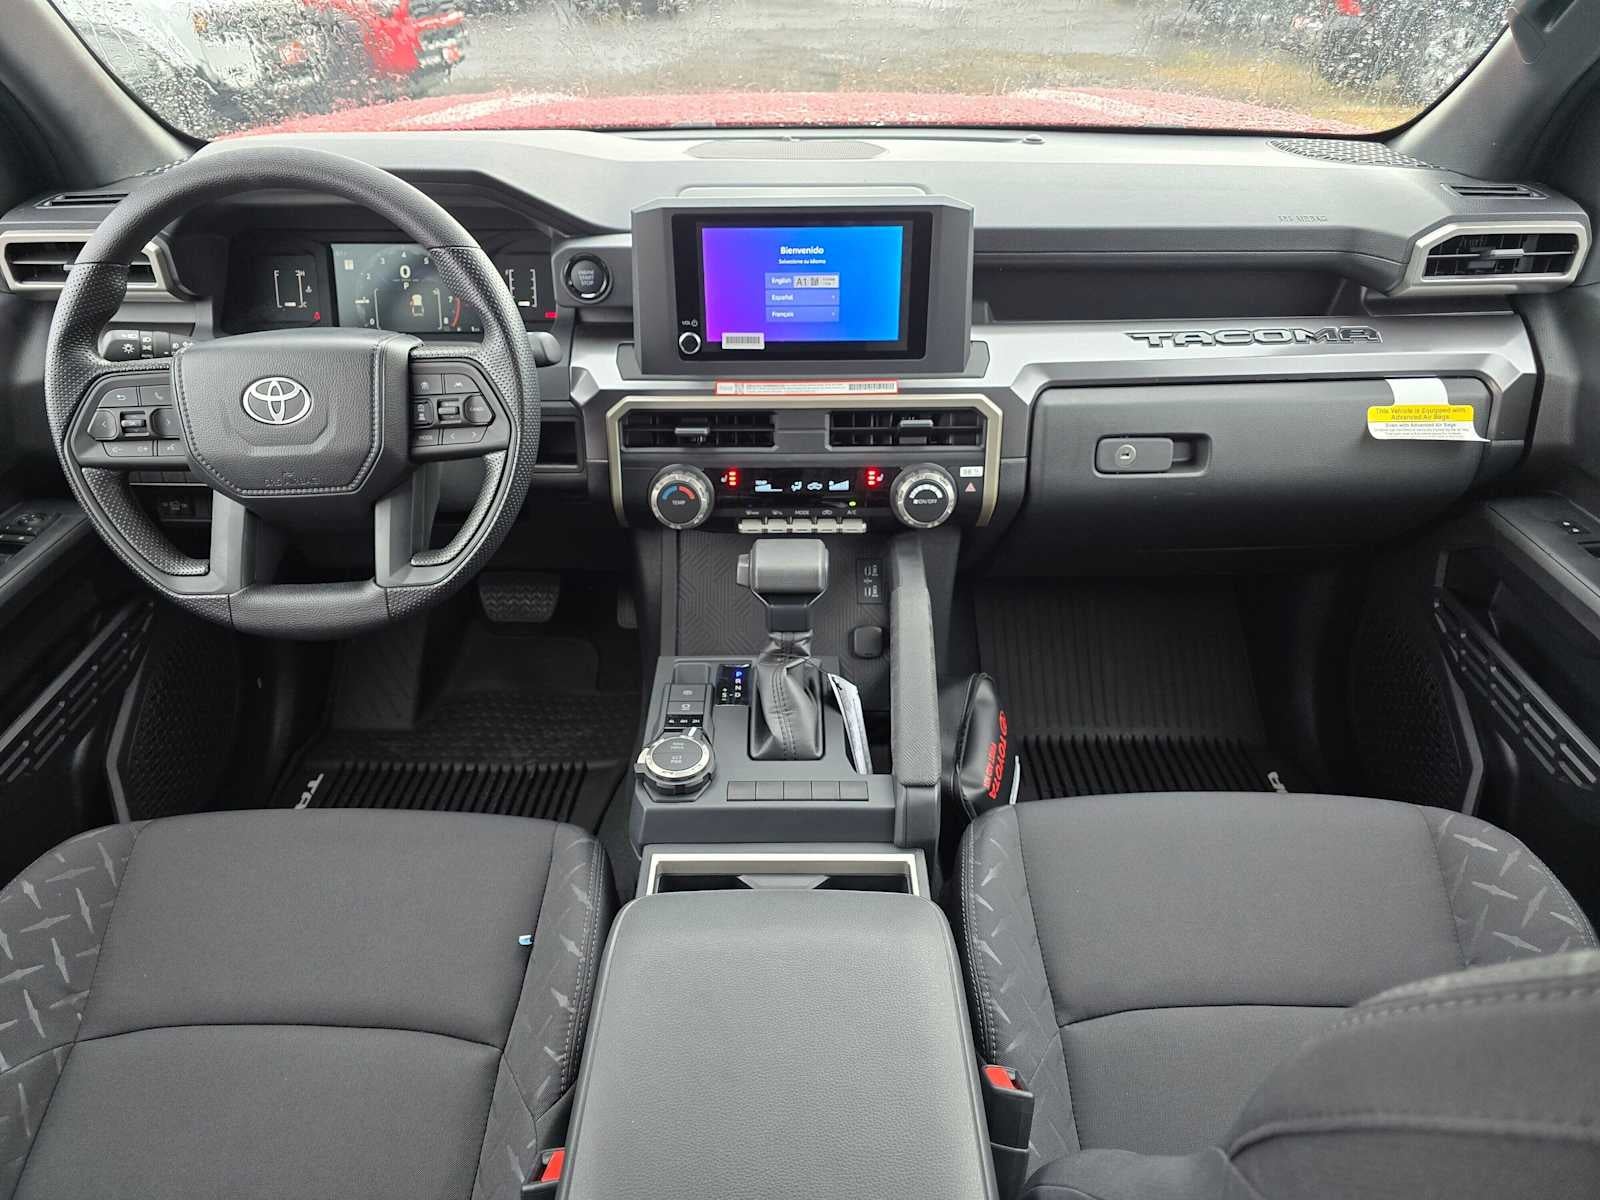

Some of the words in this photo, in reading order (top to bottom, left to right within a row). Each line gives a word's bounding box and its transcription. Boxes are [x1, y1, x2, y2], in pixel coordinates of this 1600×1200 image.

[780, 246, 825, 255] Bienvenido
[399, 264, 411, 279] 0
[1126, 325, 1383, 349] TACOMA
[1421, 407, 1451, 415] Equipped
[987, 735, 1007, 800] TOYOTA
